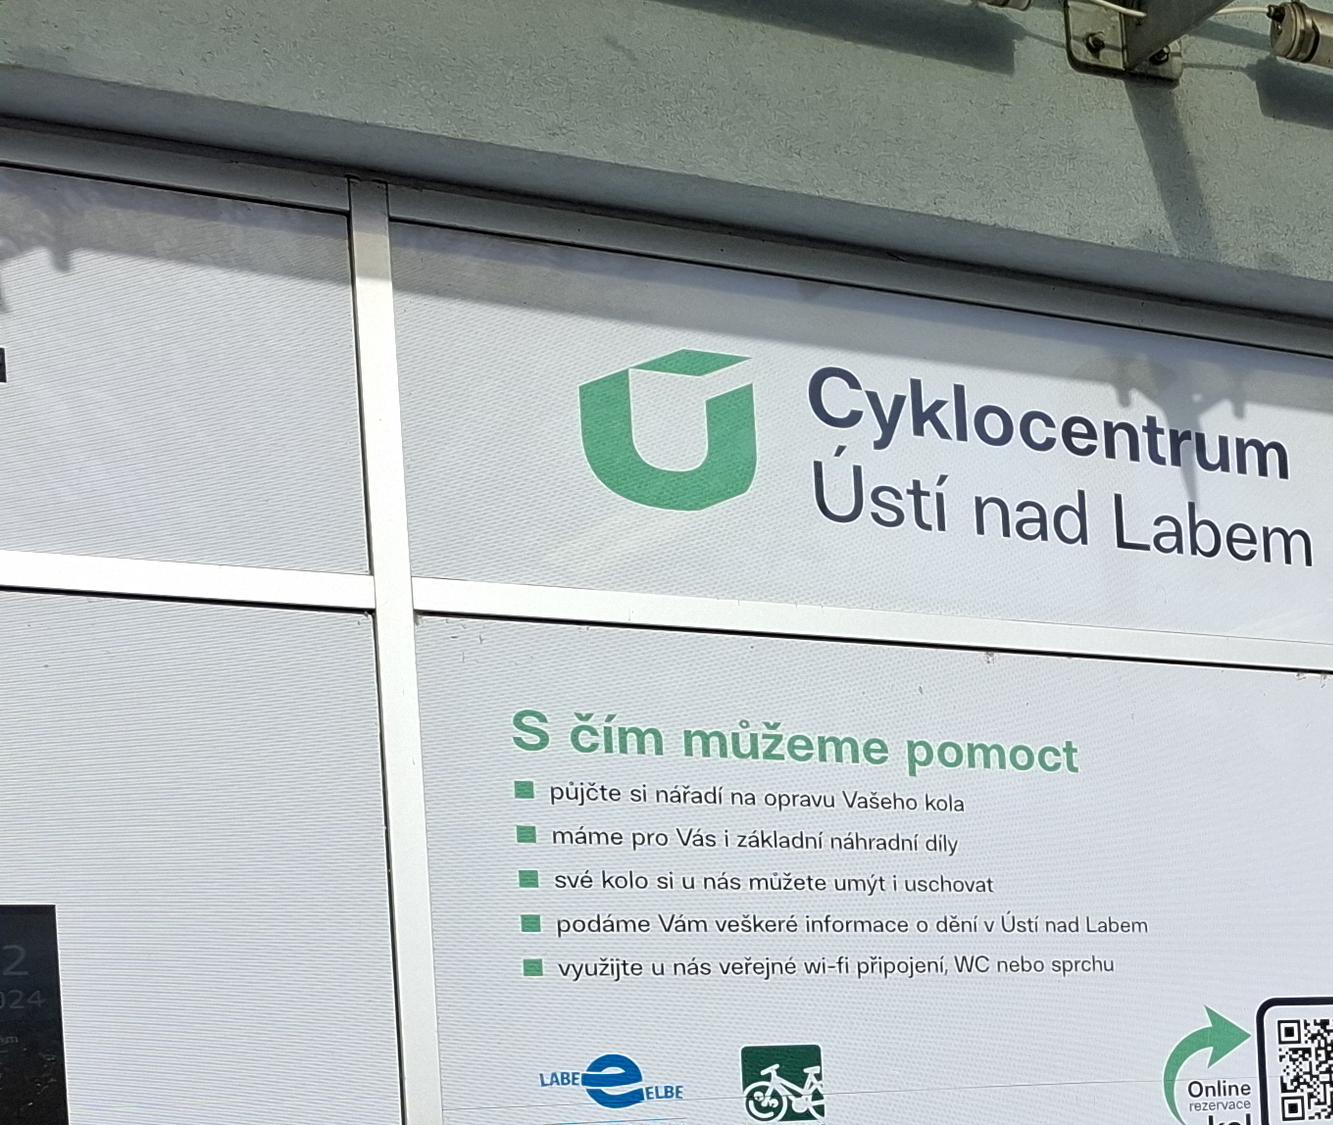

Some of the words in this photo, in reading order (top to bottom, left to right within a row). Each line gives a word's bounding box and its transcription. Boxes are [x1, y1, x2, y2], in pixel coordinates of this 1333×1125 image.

[806, 366, 1290, 480] Cyklocentrum
[811, 444, 947, 534] Ústí
[973, 489, 1090, 546] nad
[1113, 493, 1313, 568] Labem
[511, 709, 551, 753] S
[570, 713, 664, 756] čím
[683, 718, 889, 765] můžeme
[906, 738, 1079, 777] pomoct
[549, 780, 621, 805] půjčte
[630, 783, 647, 802] si
[655, 783, 723, 805] nářadí
[731, 788, 757, 806] na
[764, 790, 836, 812] opravu
[842, 790, 917, 812] Vašeho
[924, 793, 965, 812] kola
[552, 827, 624, 848] máme
[632, 830, 668, 851] pro
[675, 828, 717, 848] Vás
[723, 830, 729, 848] i
[736, 831, 824, 850] základní
[830, 832, 918, 852] náhradní
[925, 834, 958, 856] díly
[554, 870, 593, 889] své
[601, 871, 648, 890] kolo
[656, 872, 674, 890] si
[681, 876, 695, 890] u
[703, 871, 741, 891] nás
[748, 872, 826, 893] můžete
[834, 873, 885, 896] umýt
[892, 875, 898, 892] i
[905, 876, 994, 894] uschovat
[556, 914, 651, 938] podáme
[657, 915, 708, 933] Vám
[715, 913, 798, 933] veškeré
[805, 915, 908, 934] informace
[916, 920, 929, 933] o
[936, 915, 978, 934] dění
[984, 920, 994, 933] v
[1001, 911, 1038, 933] Ústí
[1045, 916, 1079, 933] nad
[1086, 915, 1148, 934] Labem
[558, 956, 643, 981] využijte
[651, 961, 664, 976] u
[673, 957, 711, 976] nás
[718, 956, 797, 980] veřejné
[804, 956, 849, 975] wi-fi
[857, 954, 948, 979] připojení,
[954, 954, 989, 974] WC
[997, 956, 1044, 974] nebo
[1052, 956, 1114, 977] sprchu
[540, 1072, 580, 1088] LABE
[646, 1085, 684, 1100] ELBE
[1188, 1080, 1251, 1099] Online
[1189, 1098, 1251, 1112] rezervace
